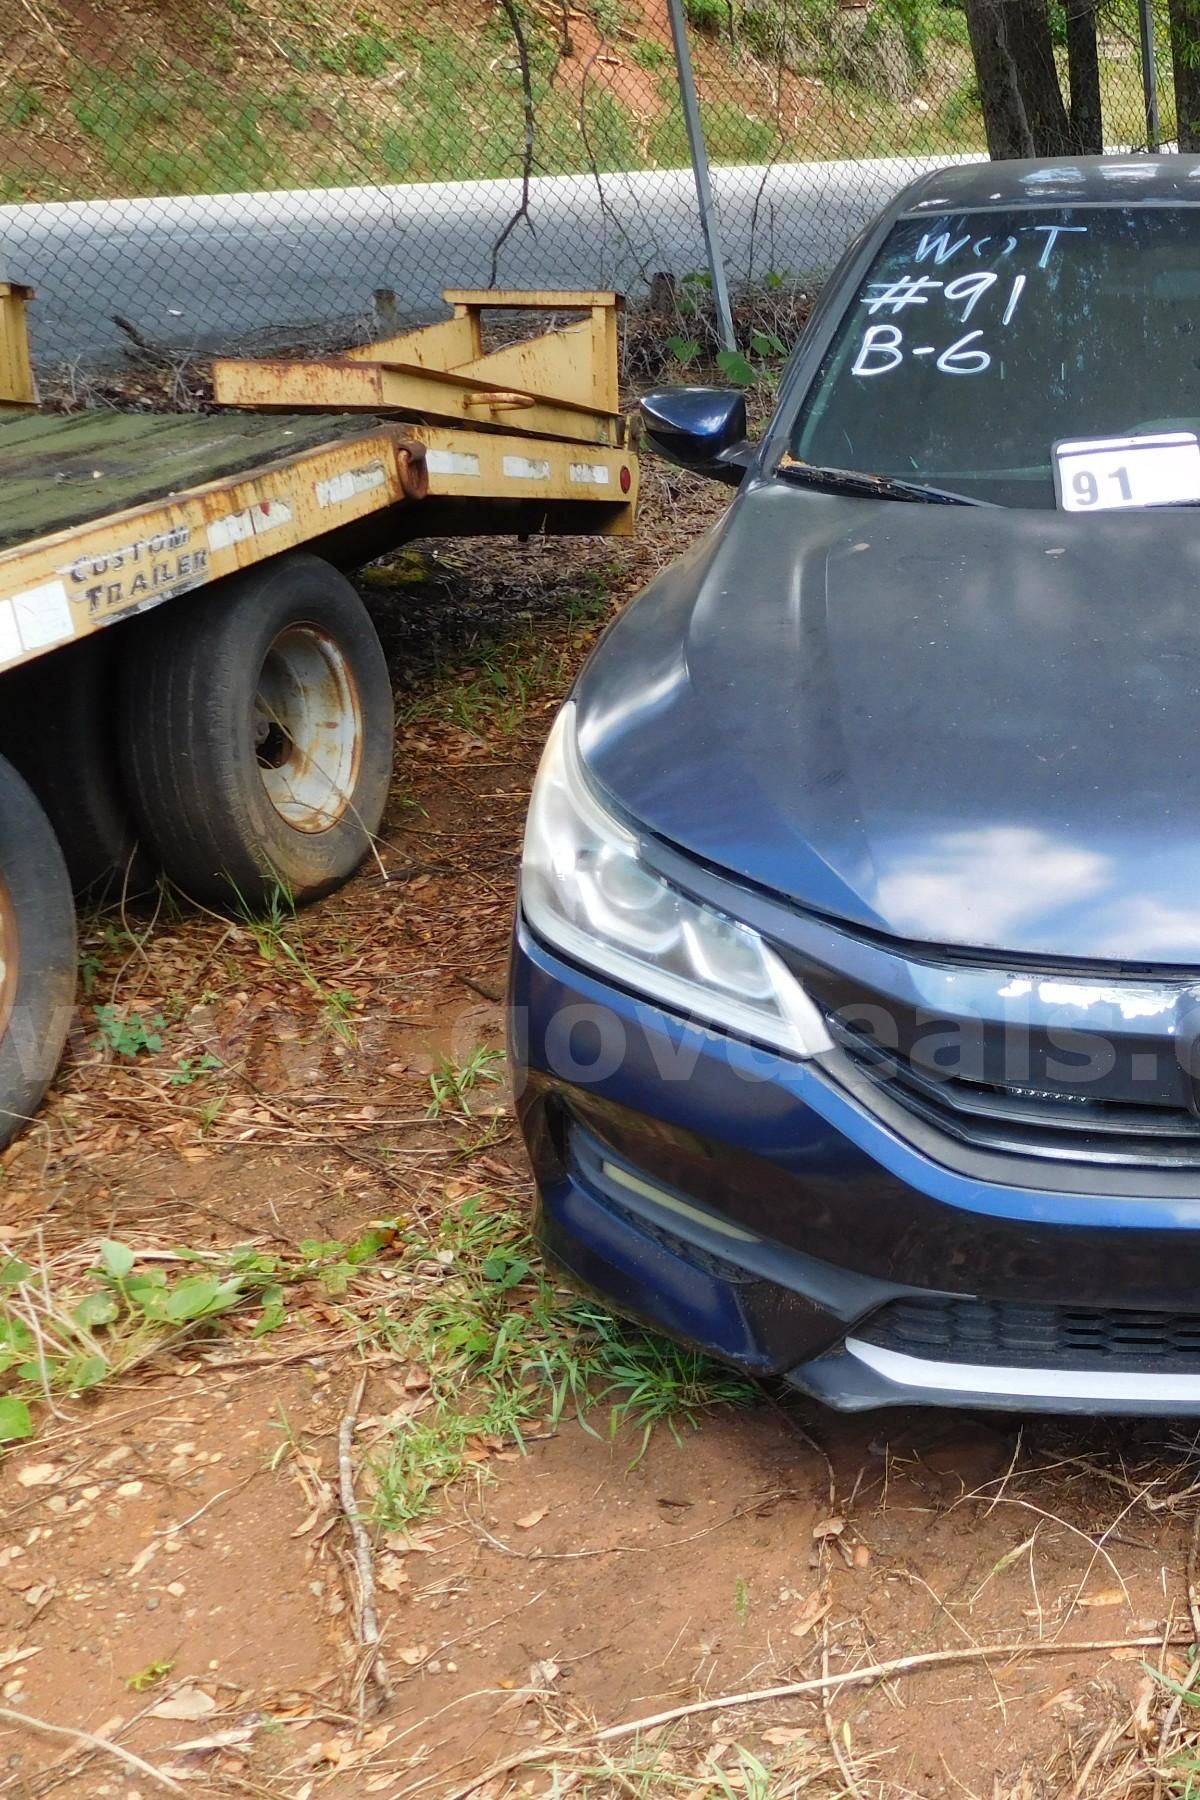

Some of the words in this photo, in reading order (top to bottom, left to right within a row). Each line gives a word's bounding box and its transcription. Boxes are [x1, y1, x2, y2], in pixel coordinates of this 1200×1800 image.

[860, 272, 1027, 325] #91
[851, 325, 991, 376] B-6
[1072, 466, 1133, 506] 91
[86, 548, 208, 613] TRAILER
